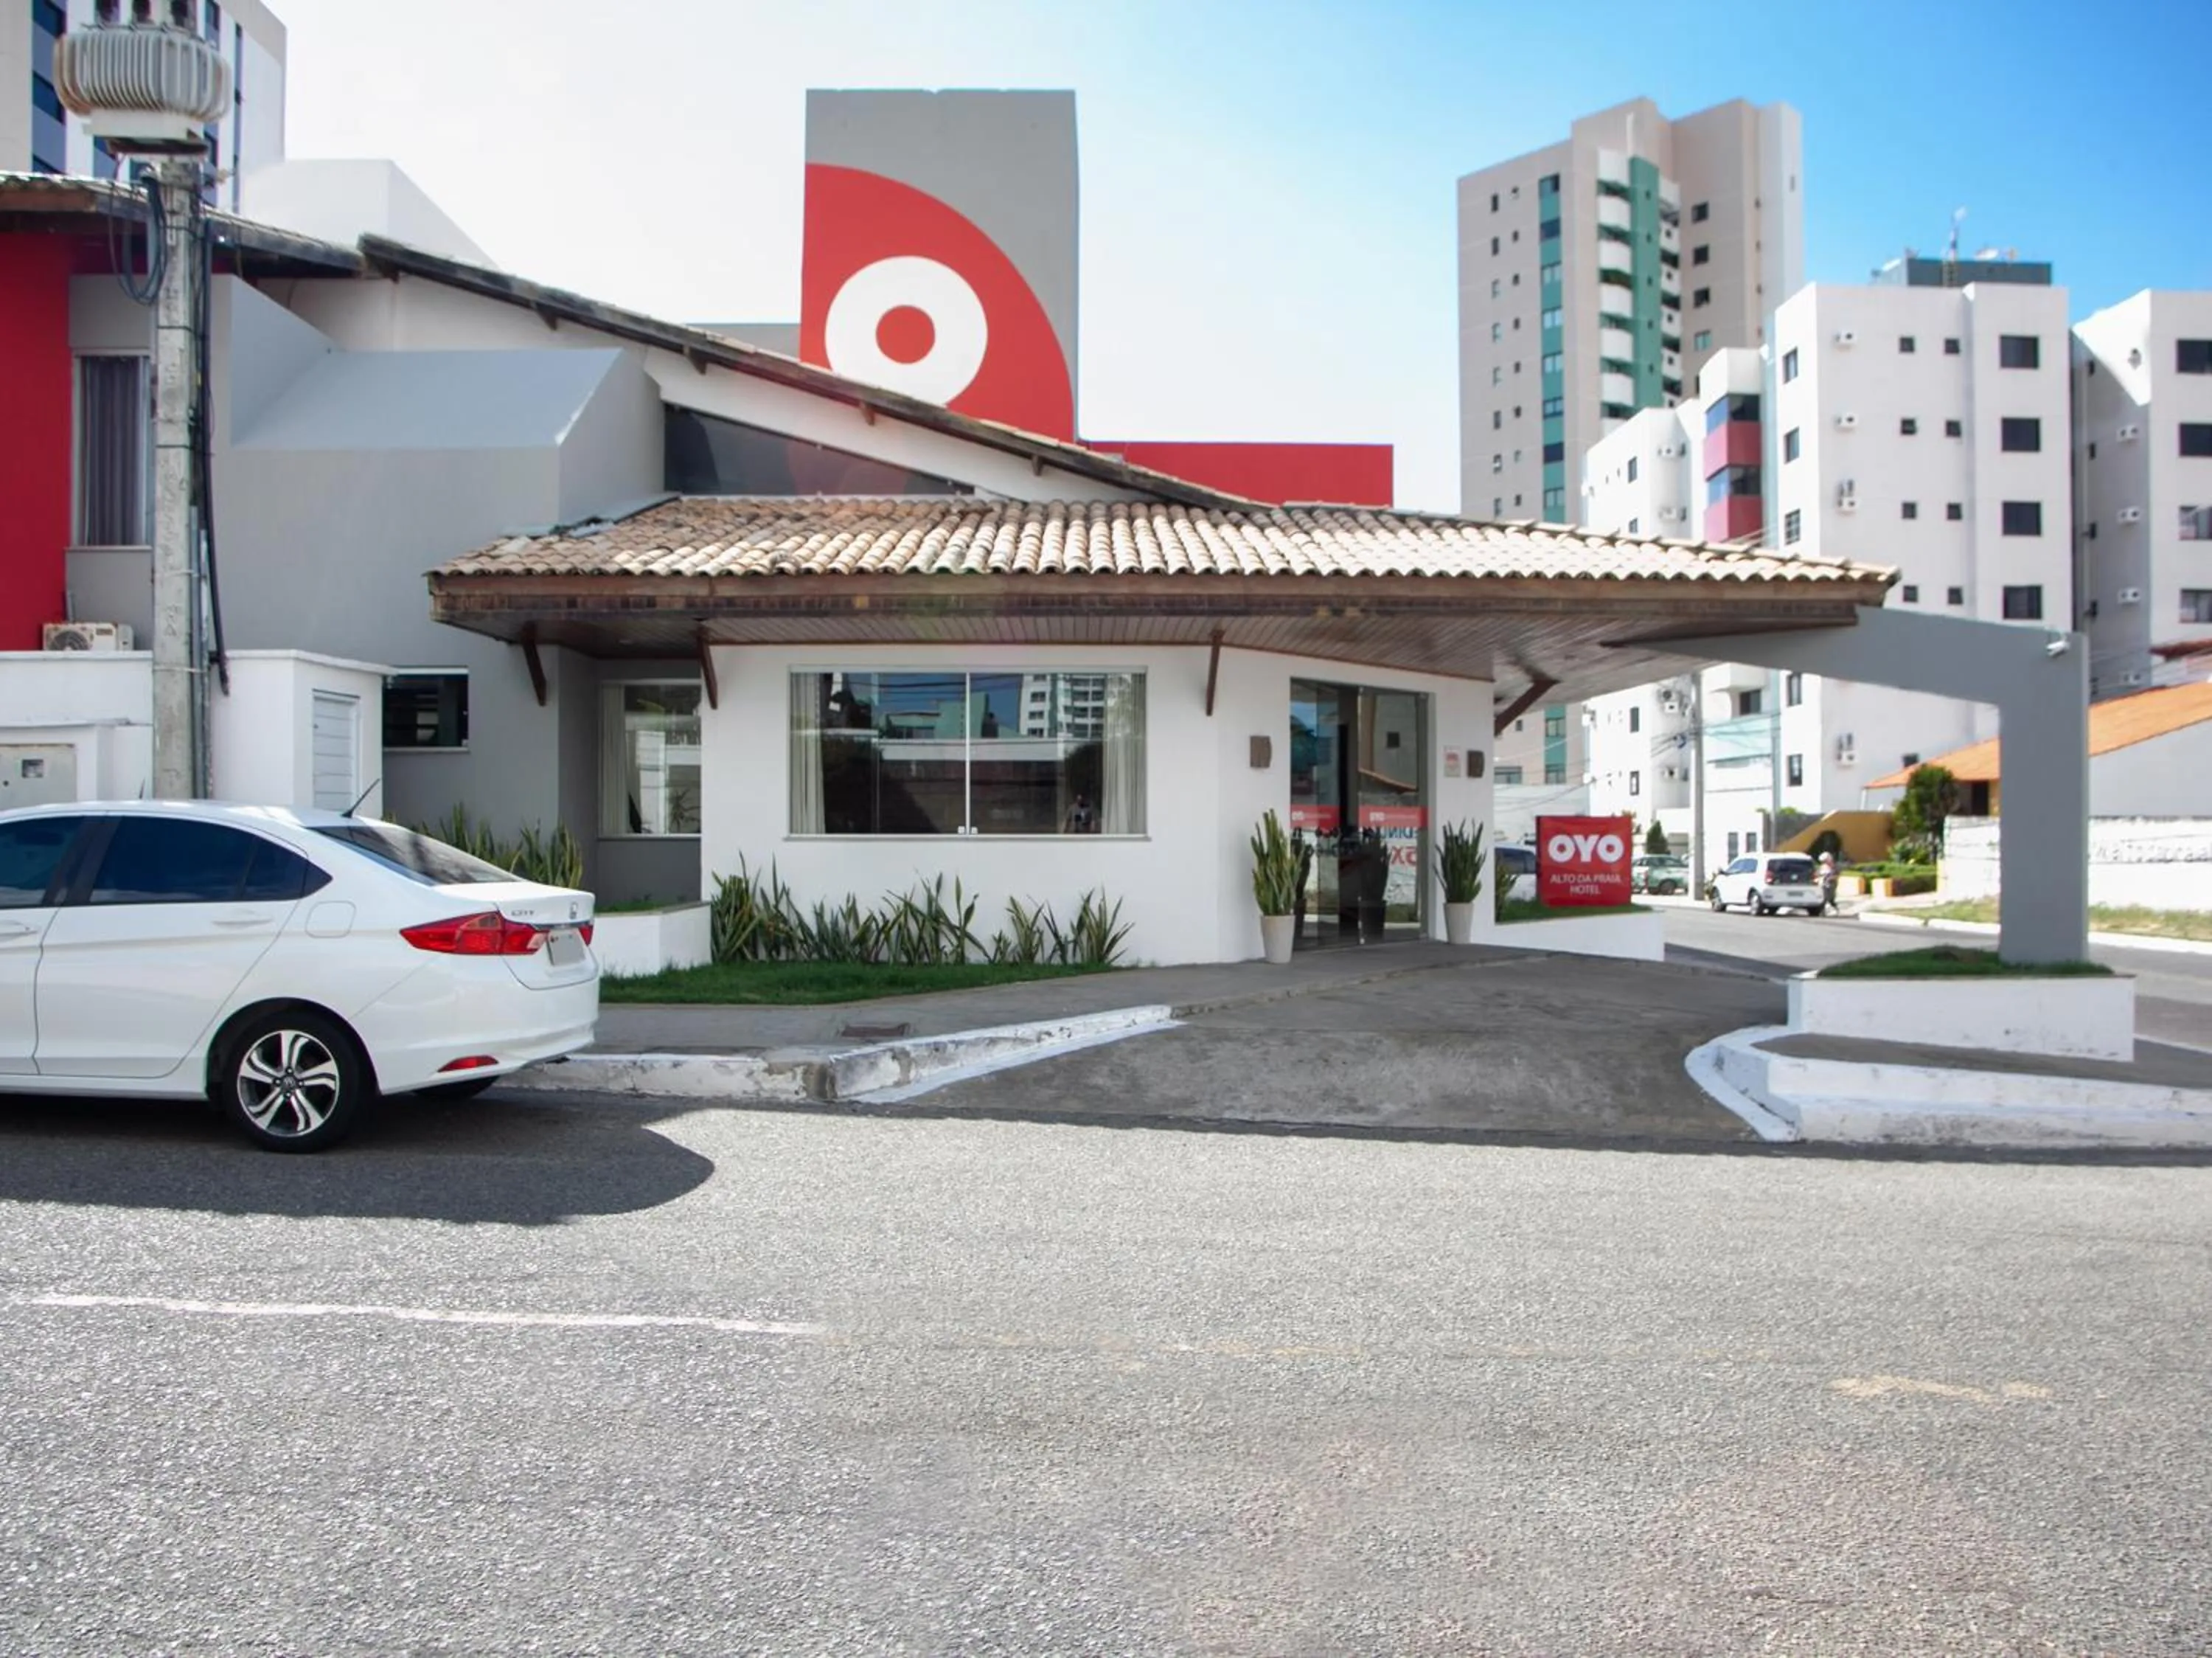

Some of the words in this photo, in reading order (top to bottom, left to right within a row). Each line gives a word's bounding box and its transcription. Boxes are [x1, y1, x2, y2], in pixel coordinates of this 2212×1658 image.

[1548, 834, 1624, 863] OYO
[1551, 874, 1576, 883] ALTO
[1578, 874, 1591, 883] DA
[1594, 874, 1621, 883] PRAIA
[1571, 885, 1600, 895] HOTEL
